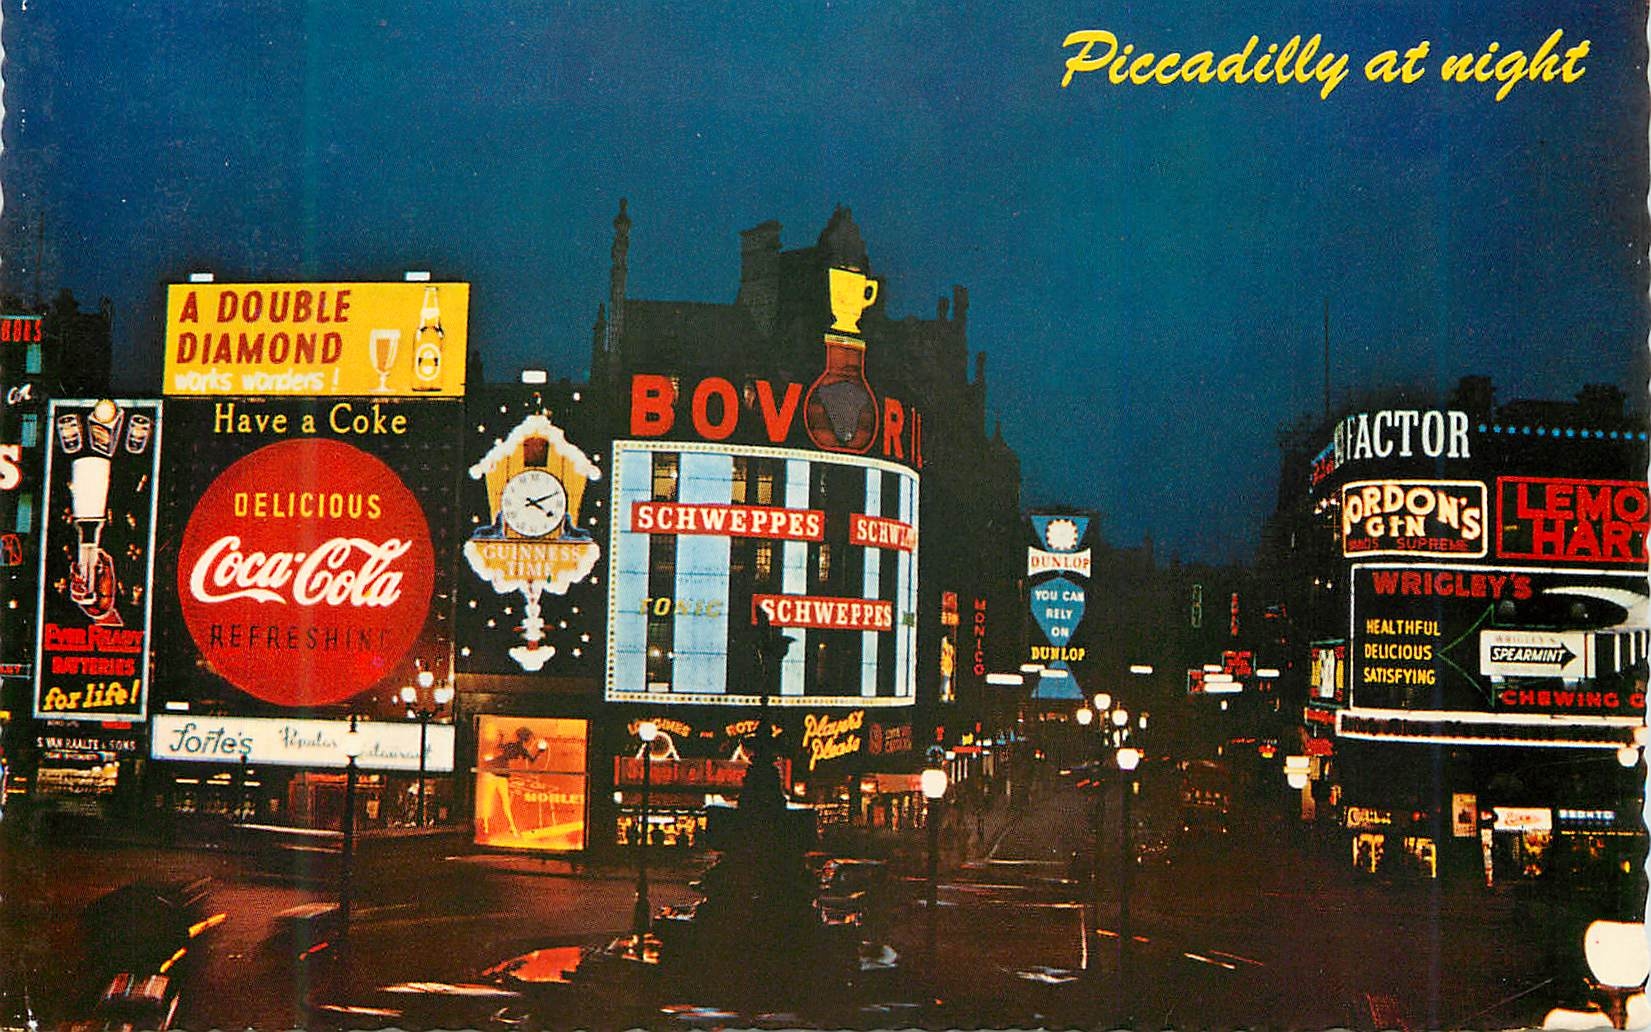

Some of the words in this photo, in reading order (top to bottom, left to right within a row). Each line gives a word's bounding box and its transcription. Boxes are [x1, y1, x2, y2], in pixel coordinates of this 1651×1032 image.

[180, 291, 198, 324] A
[216, 289, 351, 324] DOUBLE
[176, 331, 343, 364] DIAMOND
[174, 371, 232, 392] works
[241, 369, 324, 392] wonders
[213, 403, 287, 434] Have
[301, 414, 316, 434] a
[329, 403, 407, 434] Coke
[1347, 411, 1471, 461] FACTOR
[234, 492, 381, 519] DELICIOUS
[637, 507, 821, 540] SCHWEPPES
[1365, 516, 1426, 537] GIN
[483, 544, 581, 561] GUINNESS
[1031, 556, 1090, 569] DUNLOP
[190, 535, 412, 607] Coca-Cola
[1035, 589, 1058, 601] YOU
[1062, 591, 1085, 602] CAN
[1372, 571, 1533, 600] WRIGLEY'S
[760, 599, 893, 627] SCHWEPPES
[1045, 608, 1073, 620] RELY
[973, 598, 987, 676] MONICO
[1050, 627, 1070, 637] ON
[1366, 619, 1441, 637] HEALTHFUL
[1031, 646, 1086, 661] DUNLOP
[1364, 643, 1432, 661] DELICIOUS
[1491, 647, 1567, 663] SPEARMINT
[1363, 668, 1437, 685] SATISFYING
[42, 687, 82, 711] for
[82, 679, 141, 709] life!
[1501, 690, 1620, 708] CHEWING
[170, 723, 253, 755] Forte's
